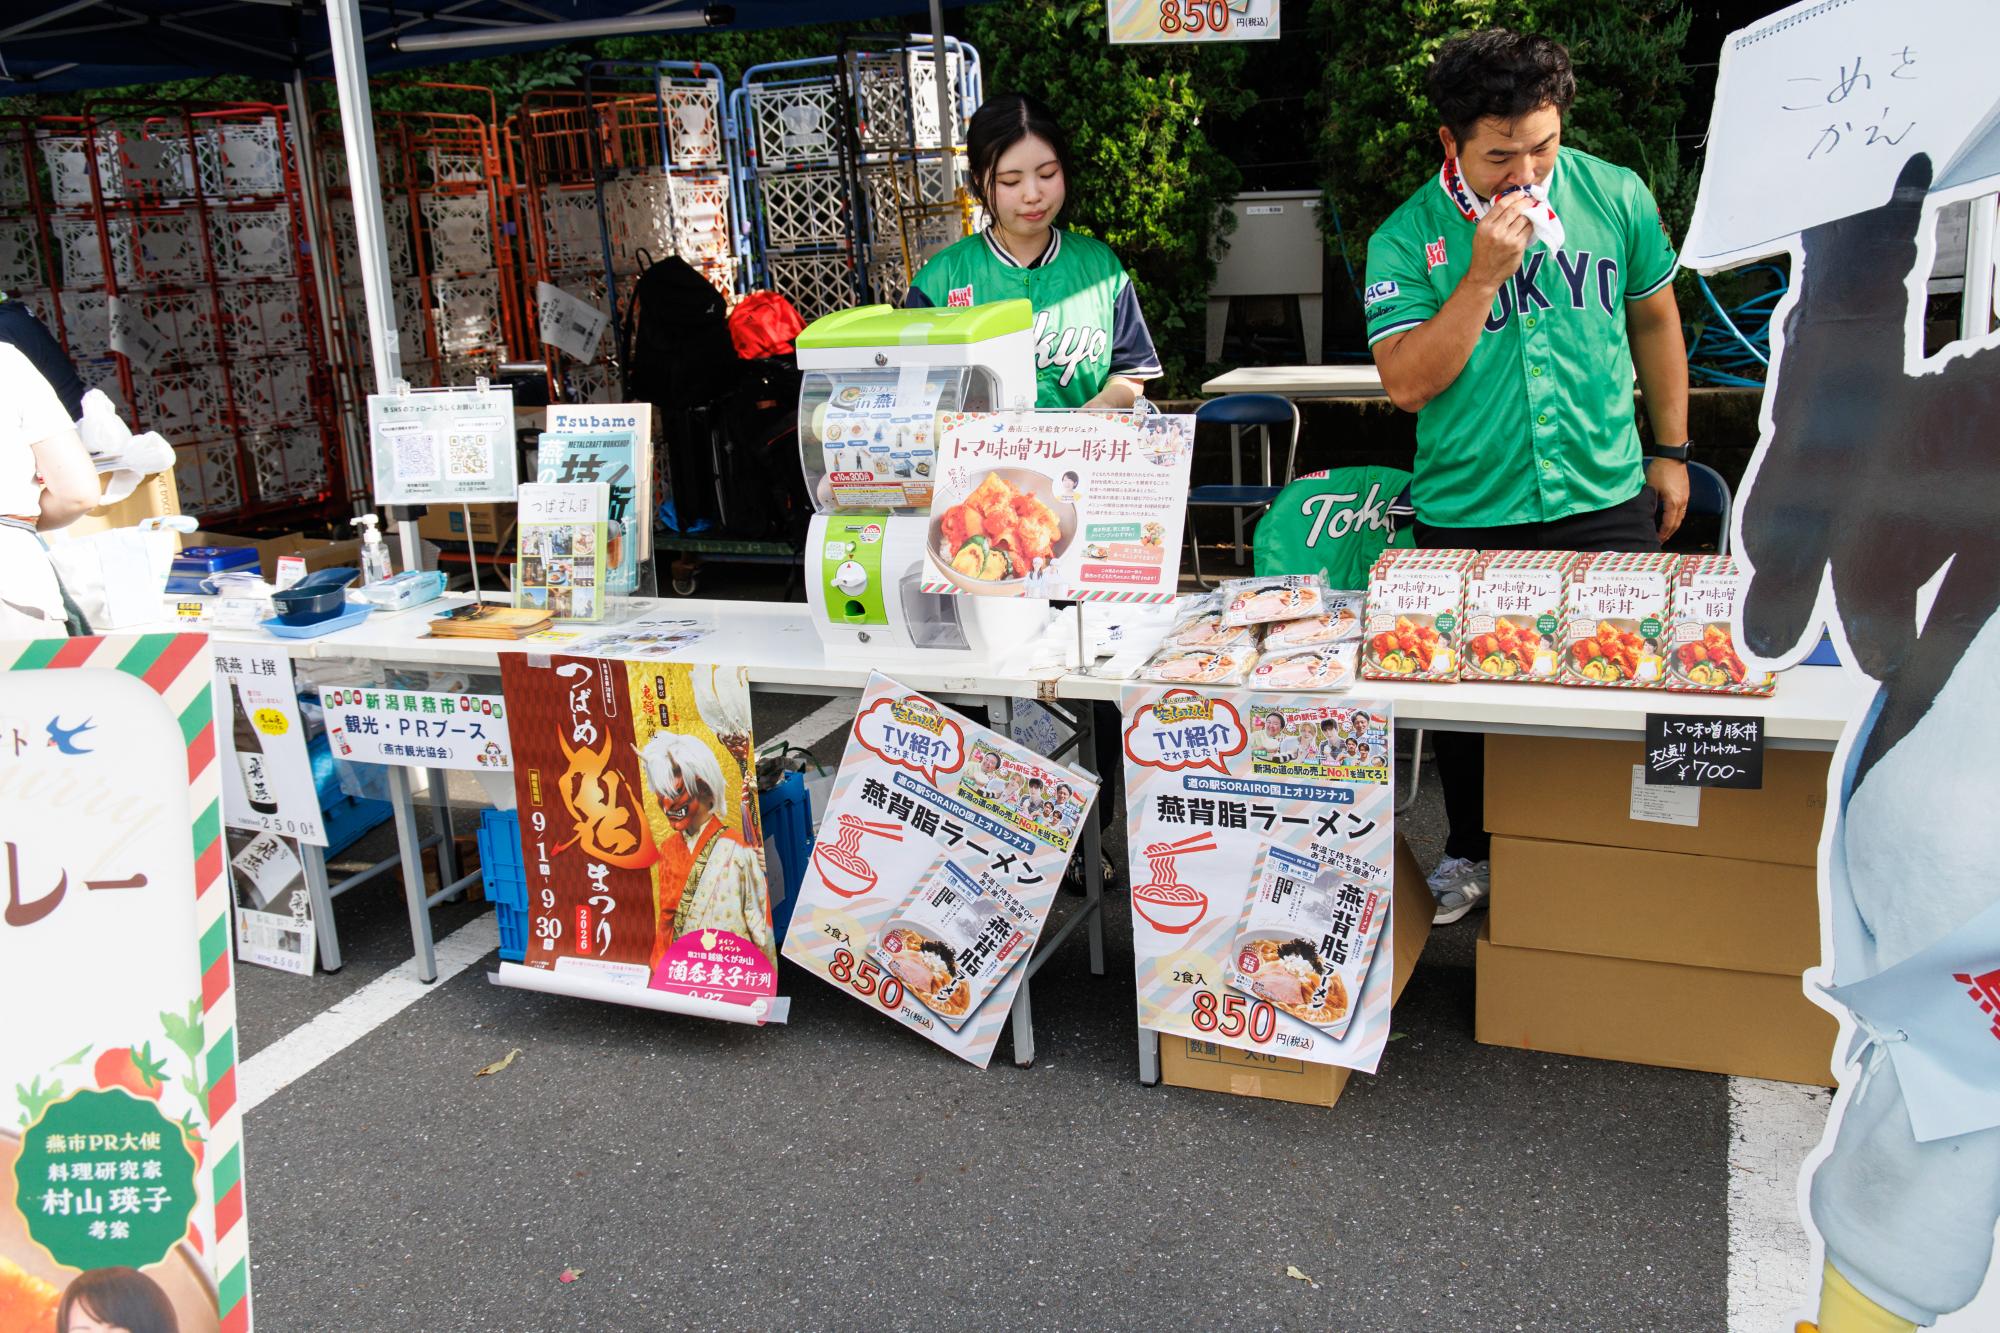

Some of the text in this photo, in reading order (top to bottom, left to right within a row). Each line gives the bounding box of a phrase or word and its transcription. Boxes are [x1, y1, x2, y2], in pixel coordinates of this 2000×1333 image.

[1159, 0, 1229, 33] 850
[1236, 18, 1268, 27] 円(税込)
[1782, 46, 1918, 111] こめを
[1365, 281, 1396, 305] ACJ
[1034, 311, 1107, 388] kyo
[556, 415, 636, 428] Tsubame
[953, 437, 1132, 463] トマ味噌カレー豚丼
[1378, 581, 1456, 598] トマ味噌カレー
[1476, 581, 1557, 598] トマ味噌カレー
[1577, 583, 1660, 601] トマ味噌カレー
[1398, 595, 1431, 610] 豚丼
[1497, 595, 1532, 611] 豚丼
[1598, 599, 1635, 615] 豚丼
[215, 657, 277, 676] 飛燕 上撰
[366, 693, 456, 715] 新潟県燕市
[344, 714, 487, 740] 観光・PRブース
[1153, 724, 1230, 750] TV紹介
[1663, 720, 1758, 742] トマ味噌豚丼
[378, 742, 454, 760] (燕市観光協会)
[882, 724, 952, 762] TV紹介
[1162, 748, 1218, 761] されました!
[1693, 742, 1753, 756] レトルトカレー
[884, 744, 935, 767] されました!
[1253, 764, 1388, 780] 新潟の道の駅の売上No.1を当てろ!
[1187, 777, 1350, 802] 道の駅SORAIRO国上オリジナル
[556, 662, 598, 745] つばめ
[586, 862, 617, 957] まつり
[896, 773, 1031, 852] 道の駅SORAIRO国上オリジナル
[1156, 795, 1376, 840] 燕背脂ラーメン
[261, 816, 308, 836] 2500
[861, 776, 1044, 885] 燕背脂ラーメン
[1310, 842, 1388, 878] 常温で持ち歩きOK!
[1310, 851, 1376, 881] お土産にも最適!
[978, 879, 1028, 923] お土産にも最適!
[980, 871, 1040, 925] 常温で持ち歩きOK!
[580, 909, 588, 950] 2026
[823, 923, 851, 947] 2食入
[955, 915, 1013, 977] 燕背脂
[1312, 883, 1366, 1009] 燕背脂 ラーメン
[828, 947, 905, 1010] 850
[1172, 970, 1208, 986] 2食入
[900, 1005, 936, 1032] 円(税込)
[1191, 989, 1277, 1044] 850
[1276, 1032, 1315, 1050] 円(税込)
[45, 1133, 162, 1153] 燕市PR大使
[48, 1160, 163, 1182] 料理研究家
[41, 1186, 172, 1216] 村山 瑛子
[88, 1221, 130, 1240] 考案
